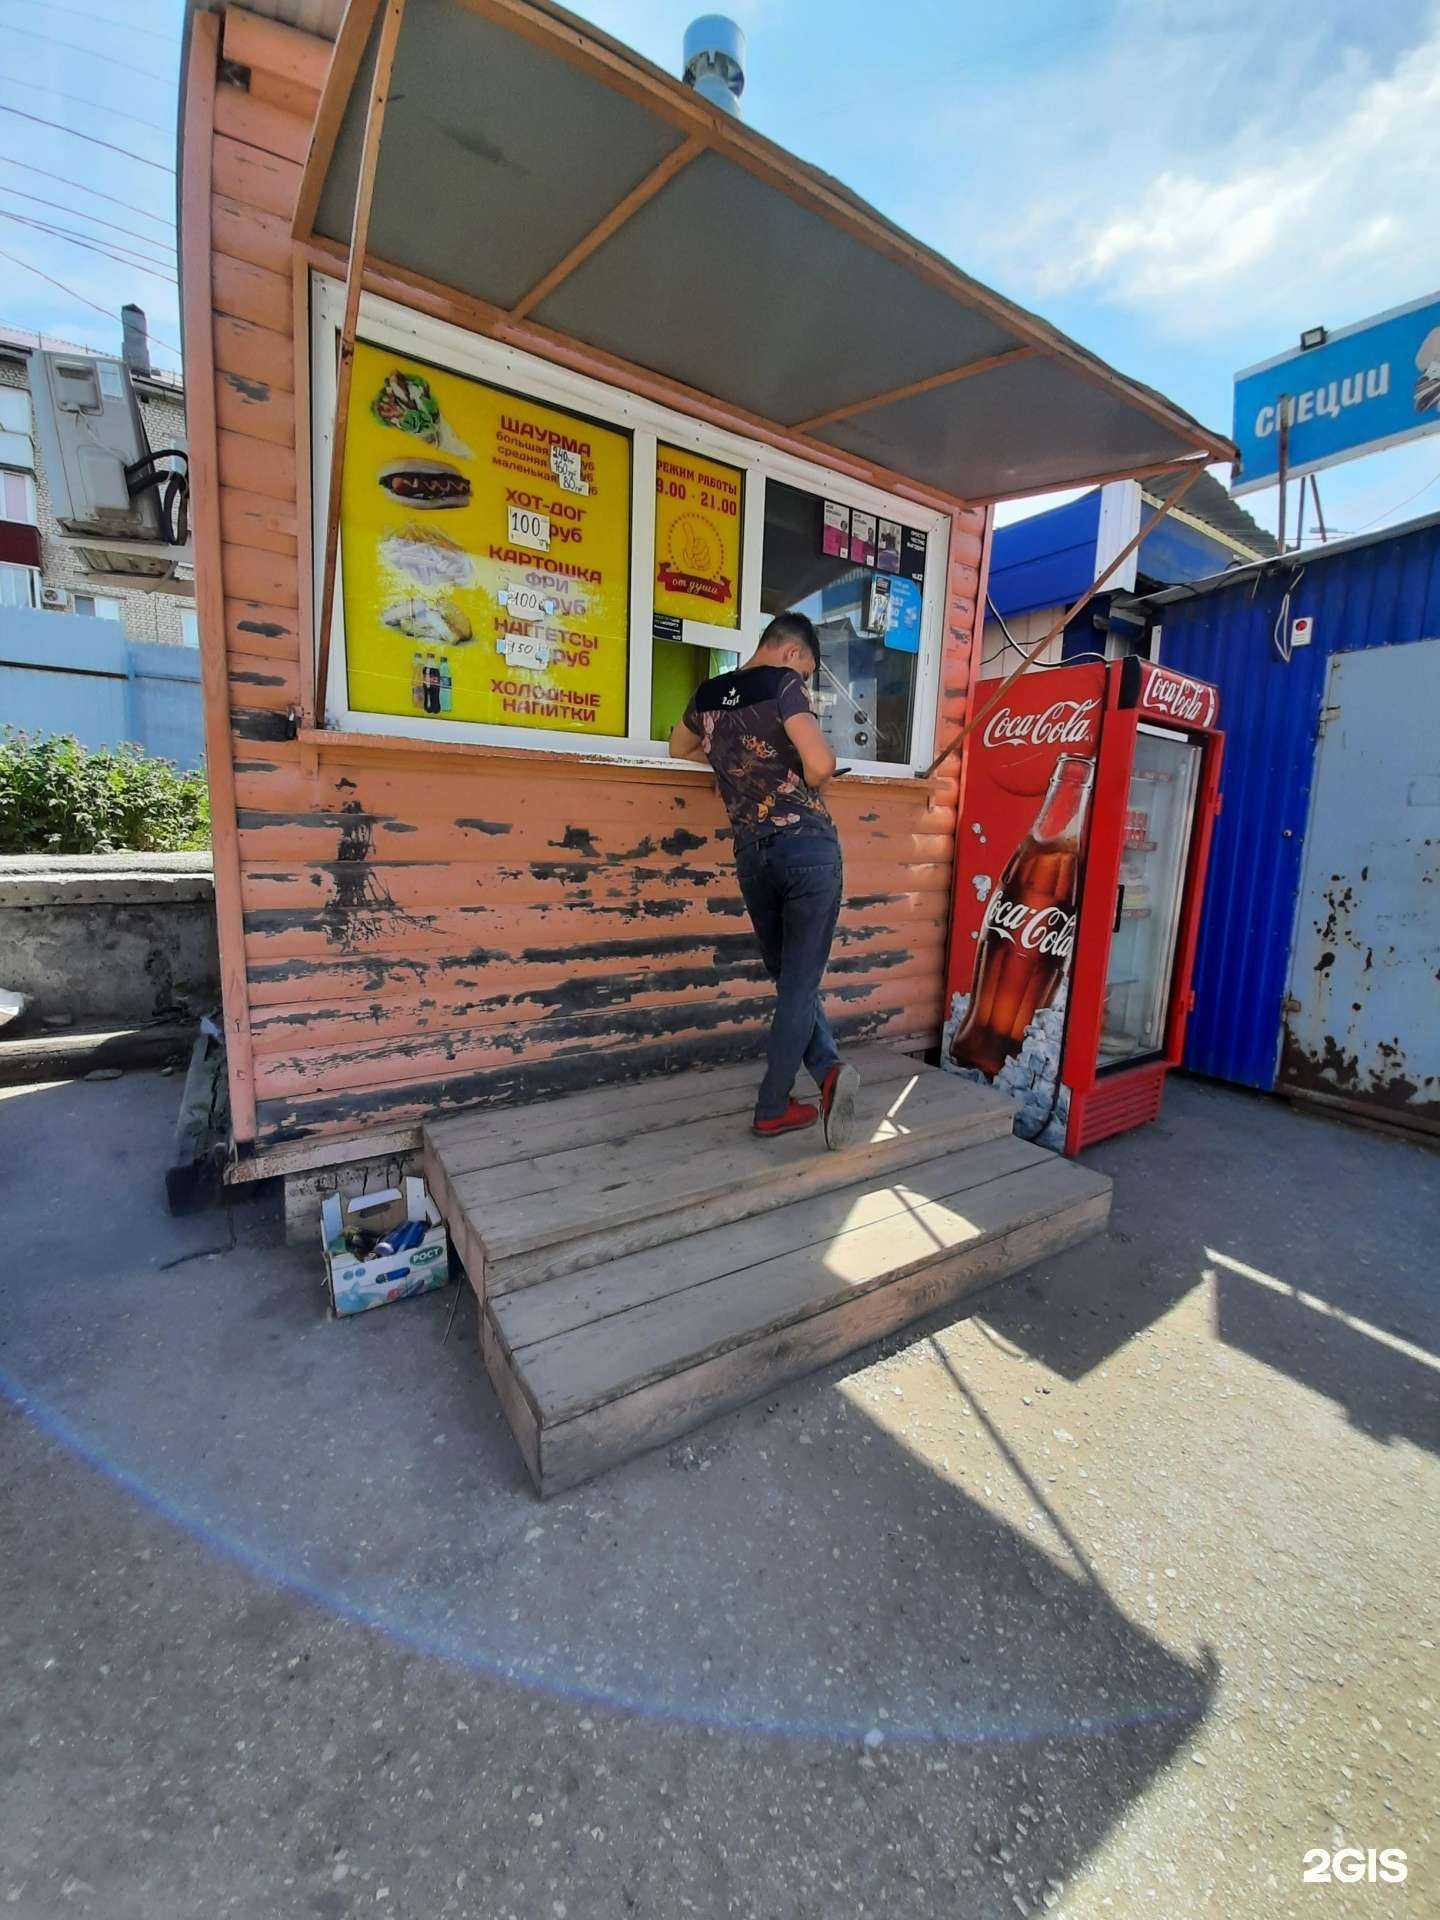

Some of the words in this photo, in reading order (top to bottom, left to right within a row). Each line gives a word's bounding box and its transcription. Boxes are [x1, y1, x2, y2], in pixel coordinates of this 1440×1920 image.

[501, 415, 591, 457] ШАУРМА
[656, 460, 695, 481] РЕЖИМ
[698, 473, 737, 496] РАБОТЫ
[505, 488, 587, 522] ХОТ-ДОГ
[700, 491, 737, 516] 21.00
[511, 512, 541, 537] 100
[549, 524, 582, 543] руб
[489, 544, 602, 584] КАРТОШКА
[525, 571, 569, 594] ФРИ
[494, 617, 599, 649] НАГГЕТСЫ
[491, 678, 601, 708] ХОЛОДНЫЕ
[1143, 668, 1204, 721] Coca-Cola
[502, 698, 596, 722] НАПИТКИ
[983, 697, 1102, 748] Coca-Cola
[412, 1247, 441, 1263] РОСТ
